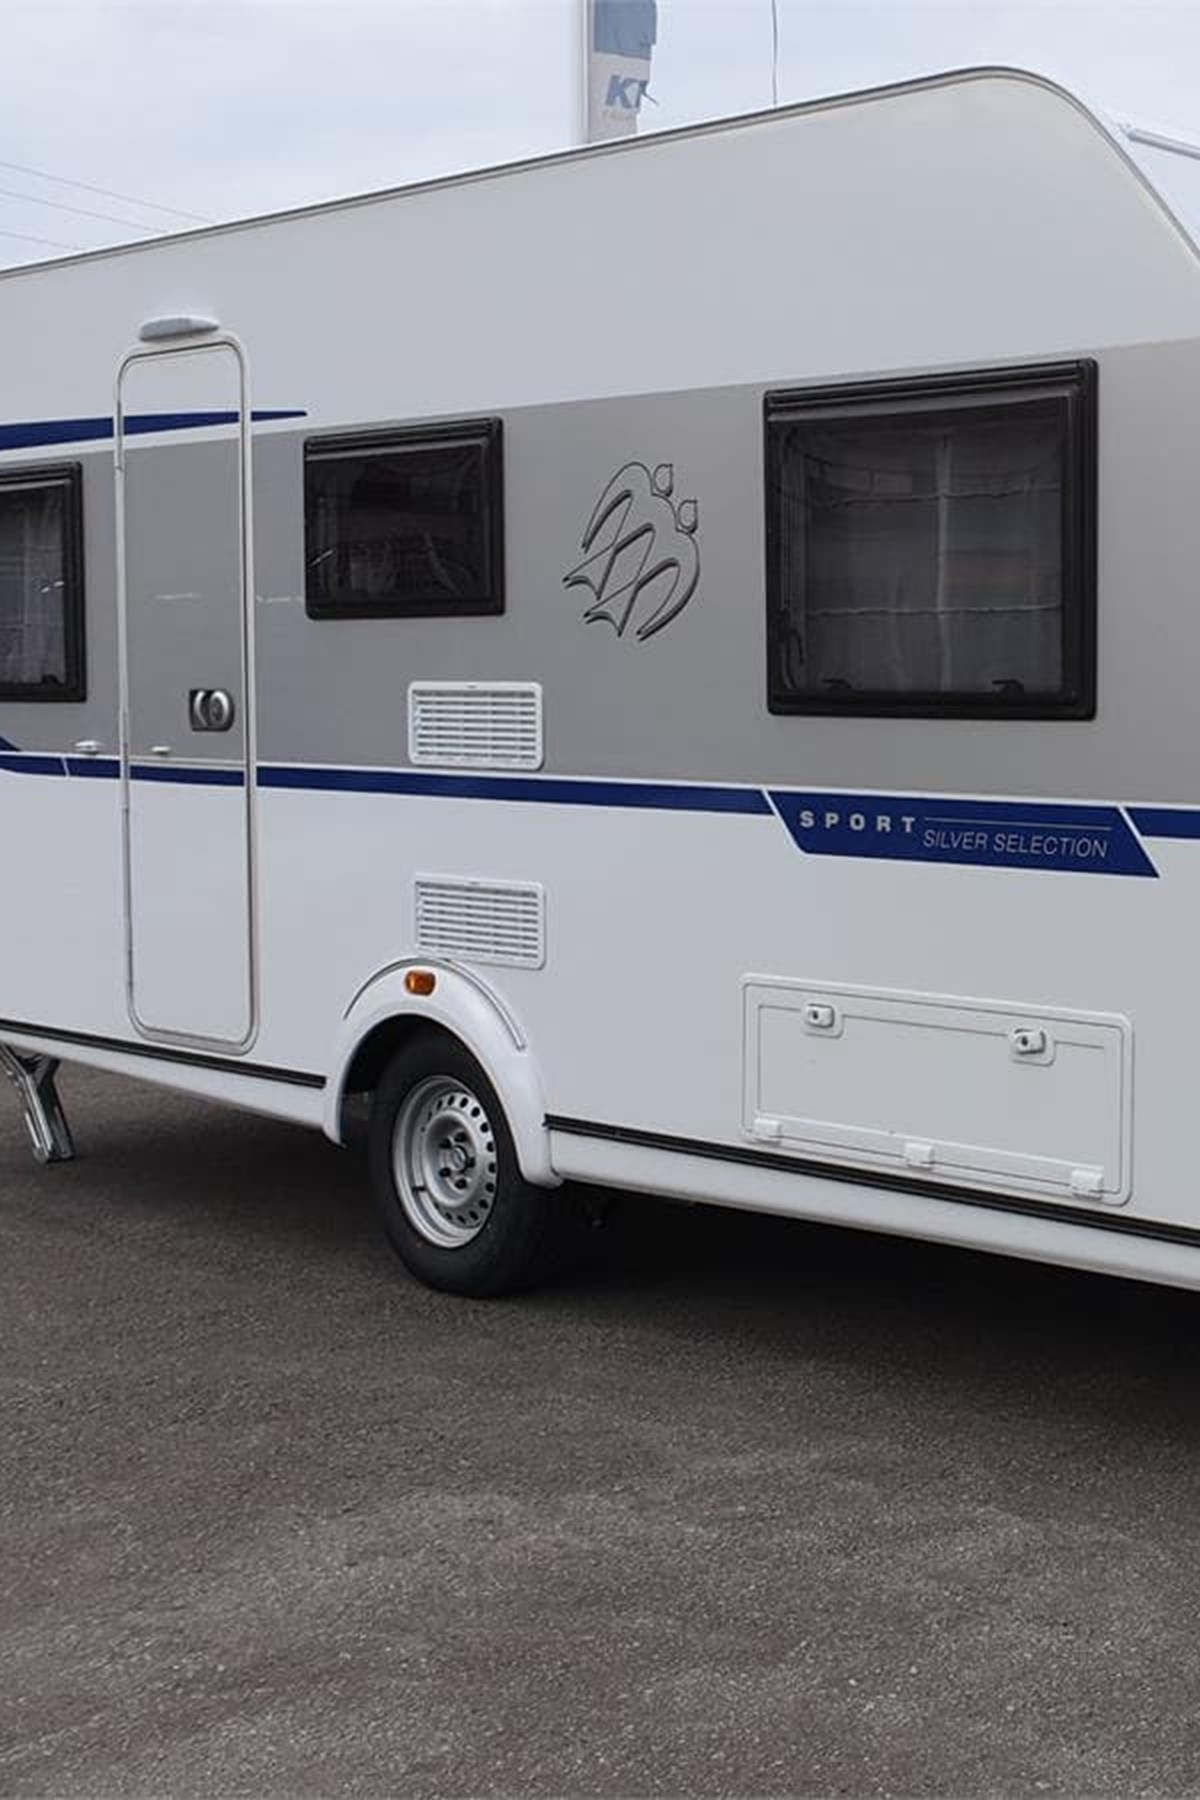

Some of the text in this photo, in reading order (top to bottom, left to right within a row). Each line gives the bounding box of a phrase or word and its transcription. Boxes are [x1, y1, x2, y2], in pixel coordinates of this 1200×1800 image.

[800, 811, 915, 833] SPORT
[923, 829, 1108, 858] SILVER SELECTION
